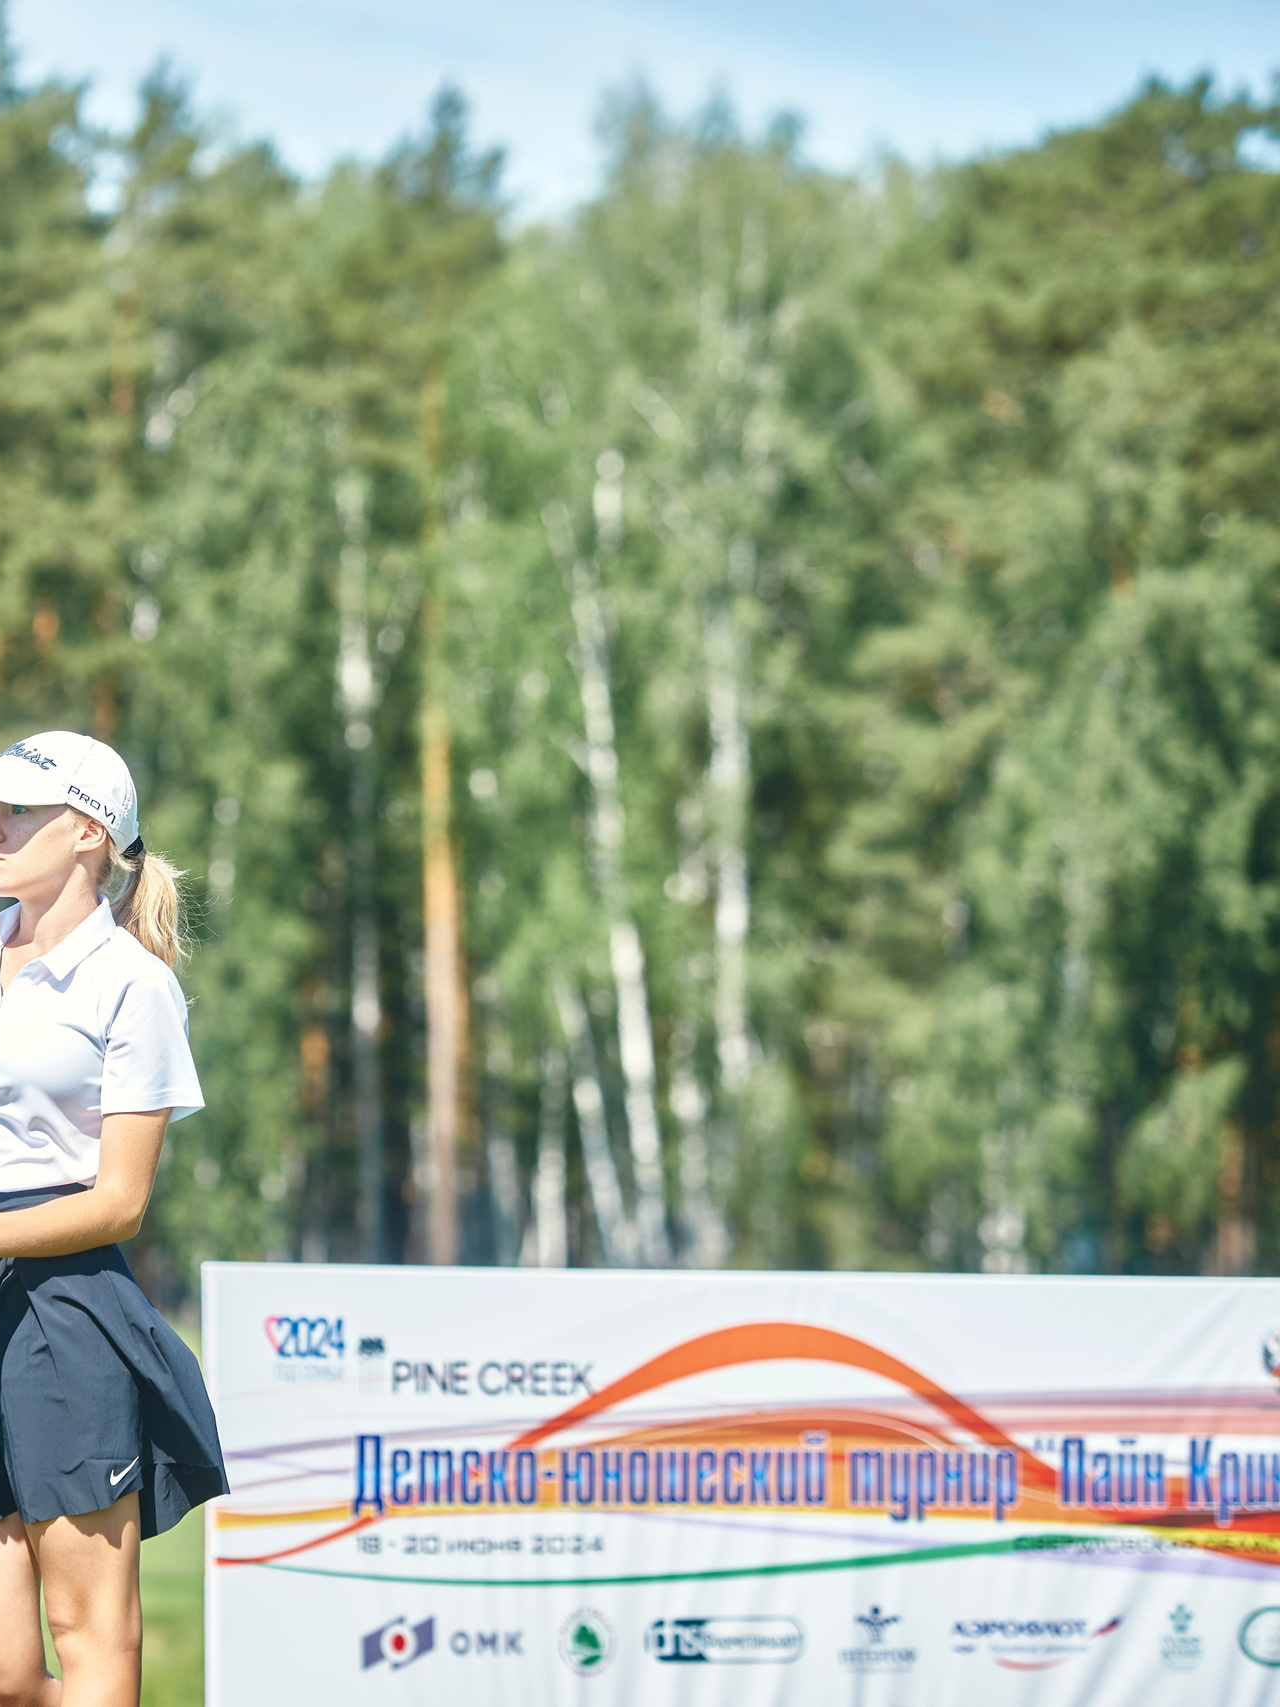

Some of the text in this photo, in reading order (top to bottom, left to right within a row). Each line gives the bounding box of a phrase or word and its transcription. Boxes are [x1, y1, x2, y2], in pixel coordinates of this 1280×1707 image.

[67, 785, 102, 811] PRO
[277, 1317, 345, 1359] 2024
[392, 1360, 593, 1396] PINE CREEK
[353, 1433, 827, 1515] Детско-юношеский
[850, 1449, 1018, 1522] турнир
[403, 1534, 440, 1555] 20
[530, 1534, 605, 1555] 2024
[448, 1630, 525, 1657] ОМК
